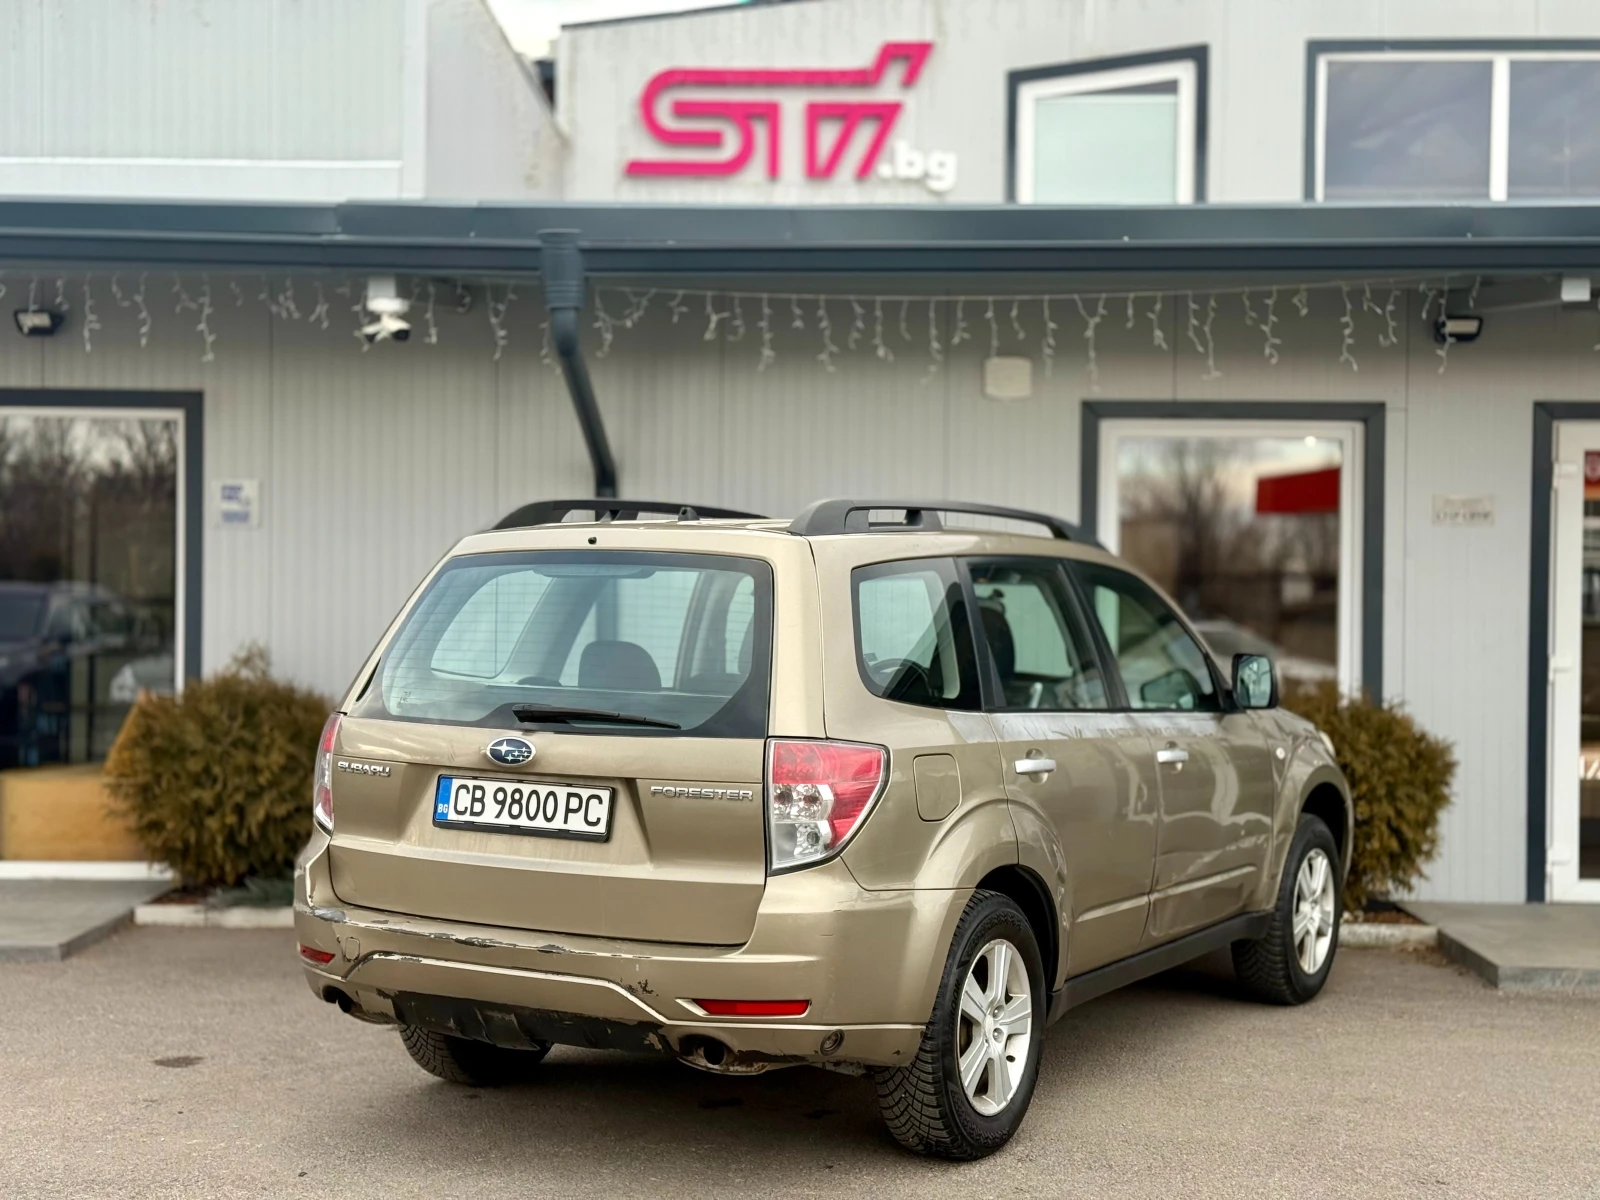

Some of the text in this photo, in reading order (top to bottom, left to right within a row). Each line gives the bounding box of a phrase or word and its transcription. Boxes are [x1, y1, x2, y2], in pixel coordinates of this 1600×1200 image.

[337, 761, 391, 777] SUBARU
[650, 786, 753, 801] FORESTER
[437, 803, 448, 814] BG
[454, 784, 603, 827] CB 9800 PC
